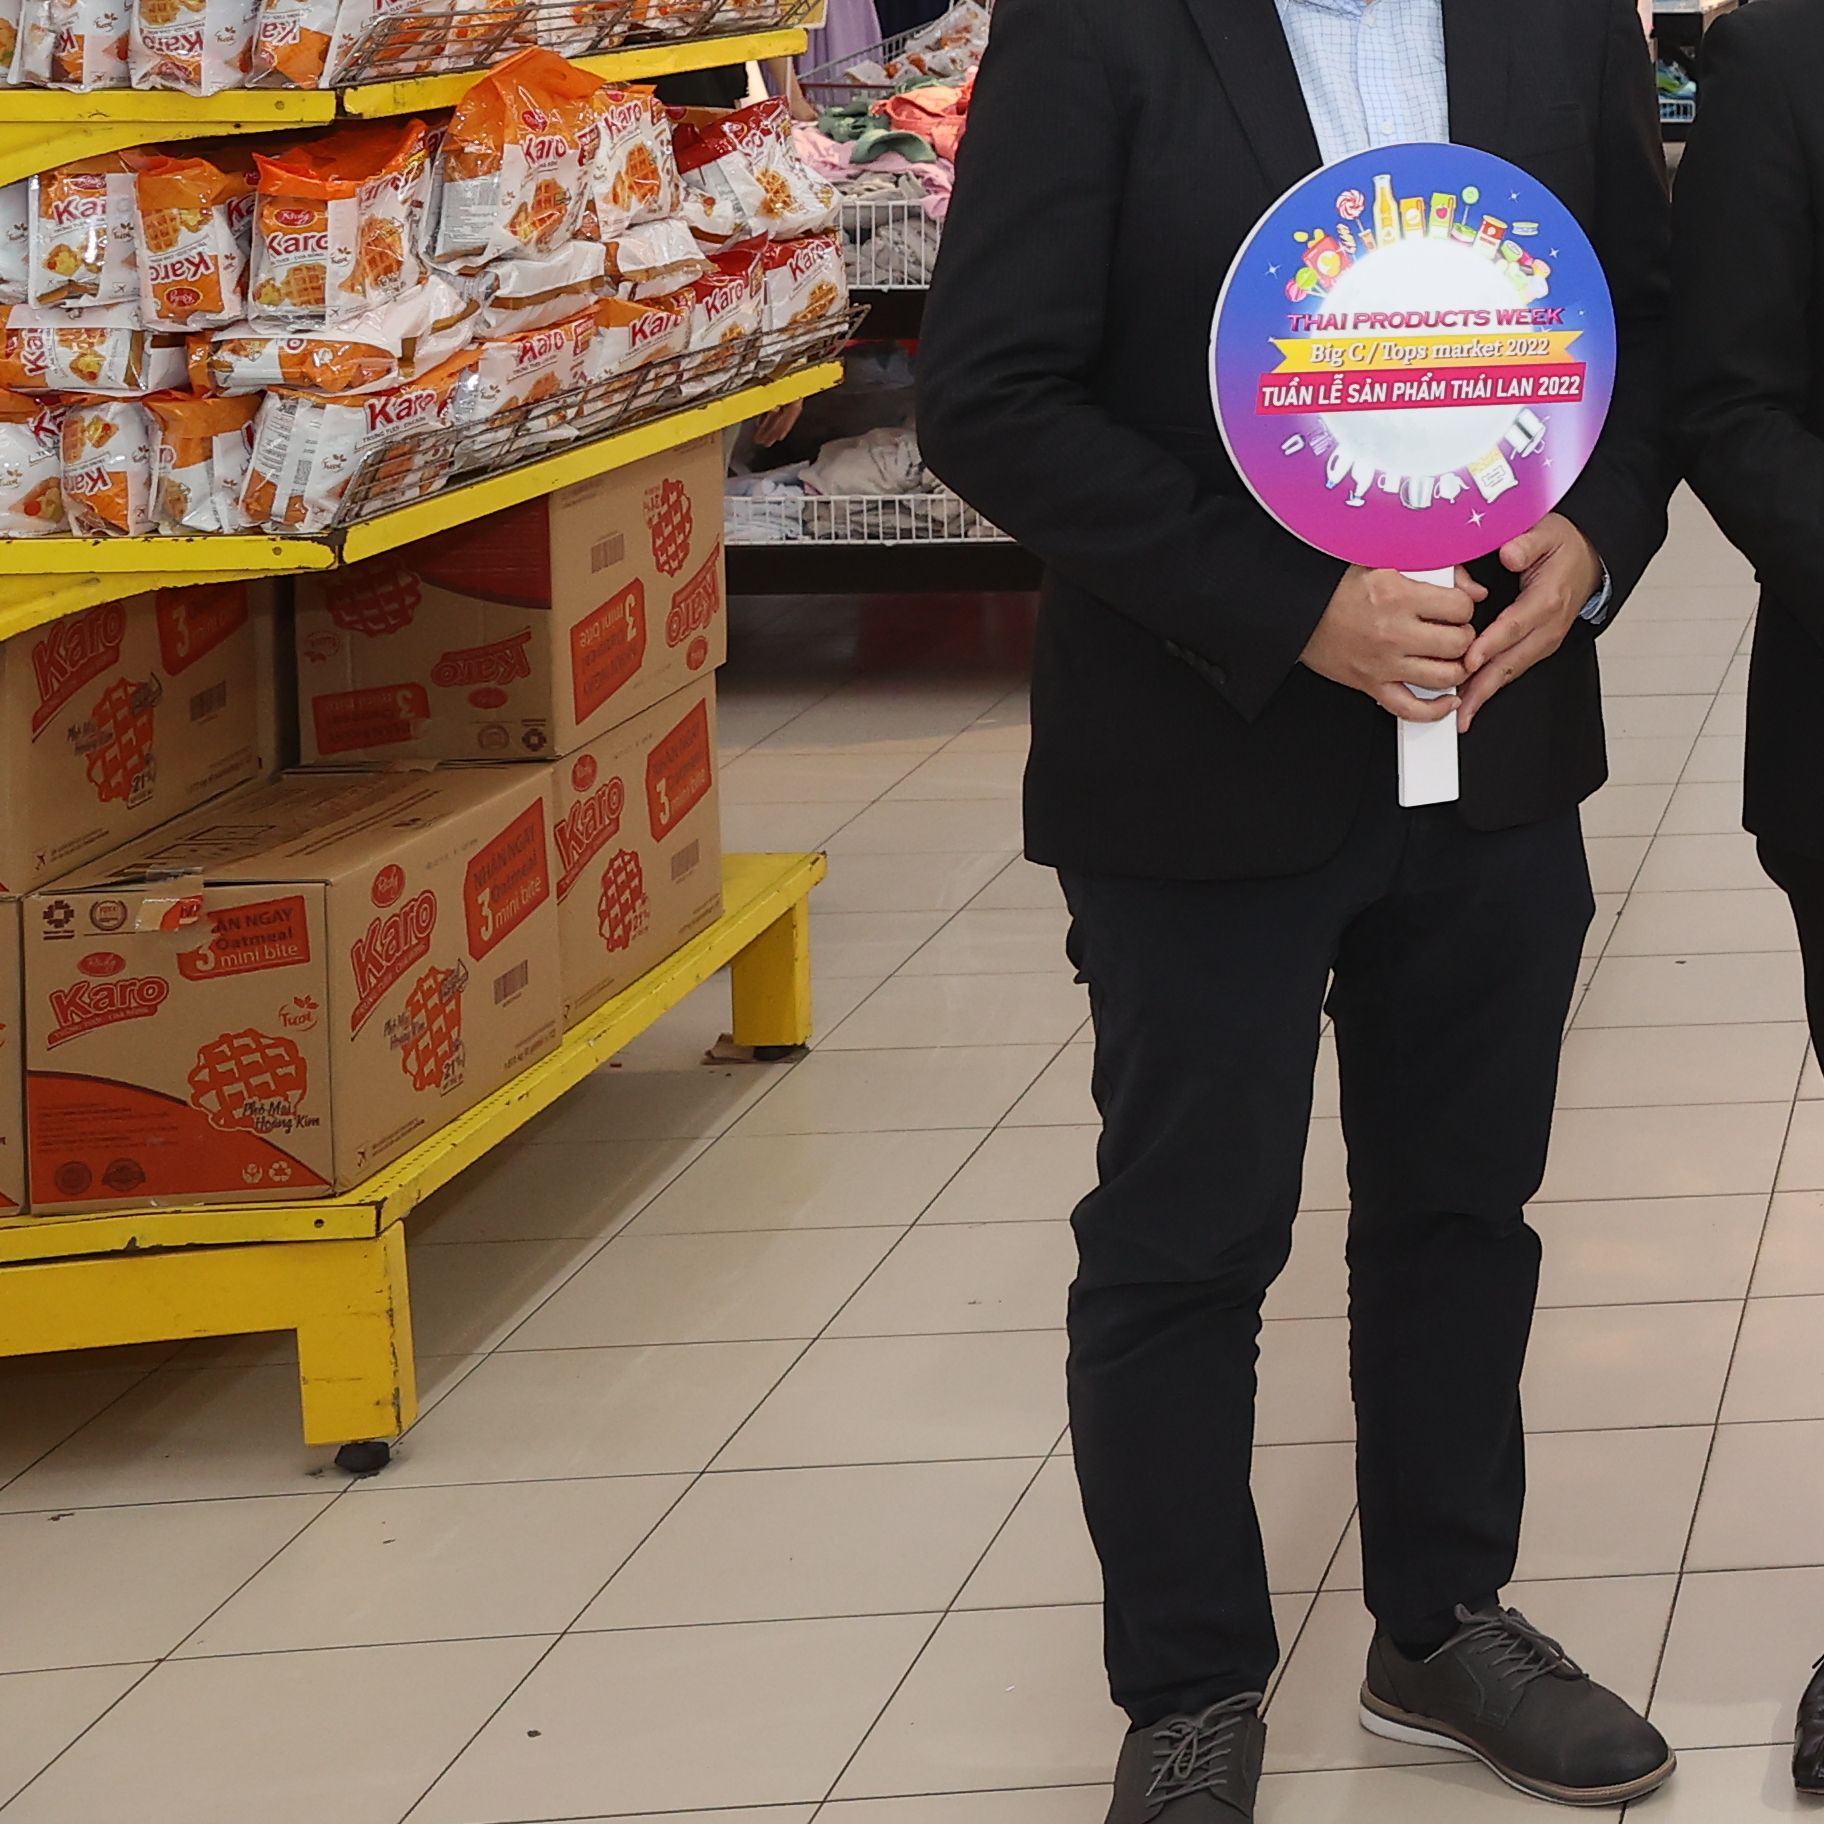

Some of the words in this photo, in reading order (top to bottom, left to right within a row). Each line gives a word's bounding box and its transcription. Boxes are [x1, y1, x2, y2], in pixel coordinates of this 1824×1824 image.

[1261, 379, 1313, 407] TUẦN
[1318, 373, 1343, 404] LỄ
[1348, 376, 1385, 402] SẢN
[1392, 372, 1446, 401] PHẨM
[1451, 373, 1493, 400] THÁI
[1497, 378, 1533, 397] LAN
[1538, 376, 1581, 395] 2022
[50, 976, 169, 1027] Karo
